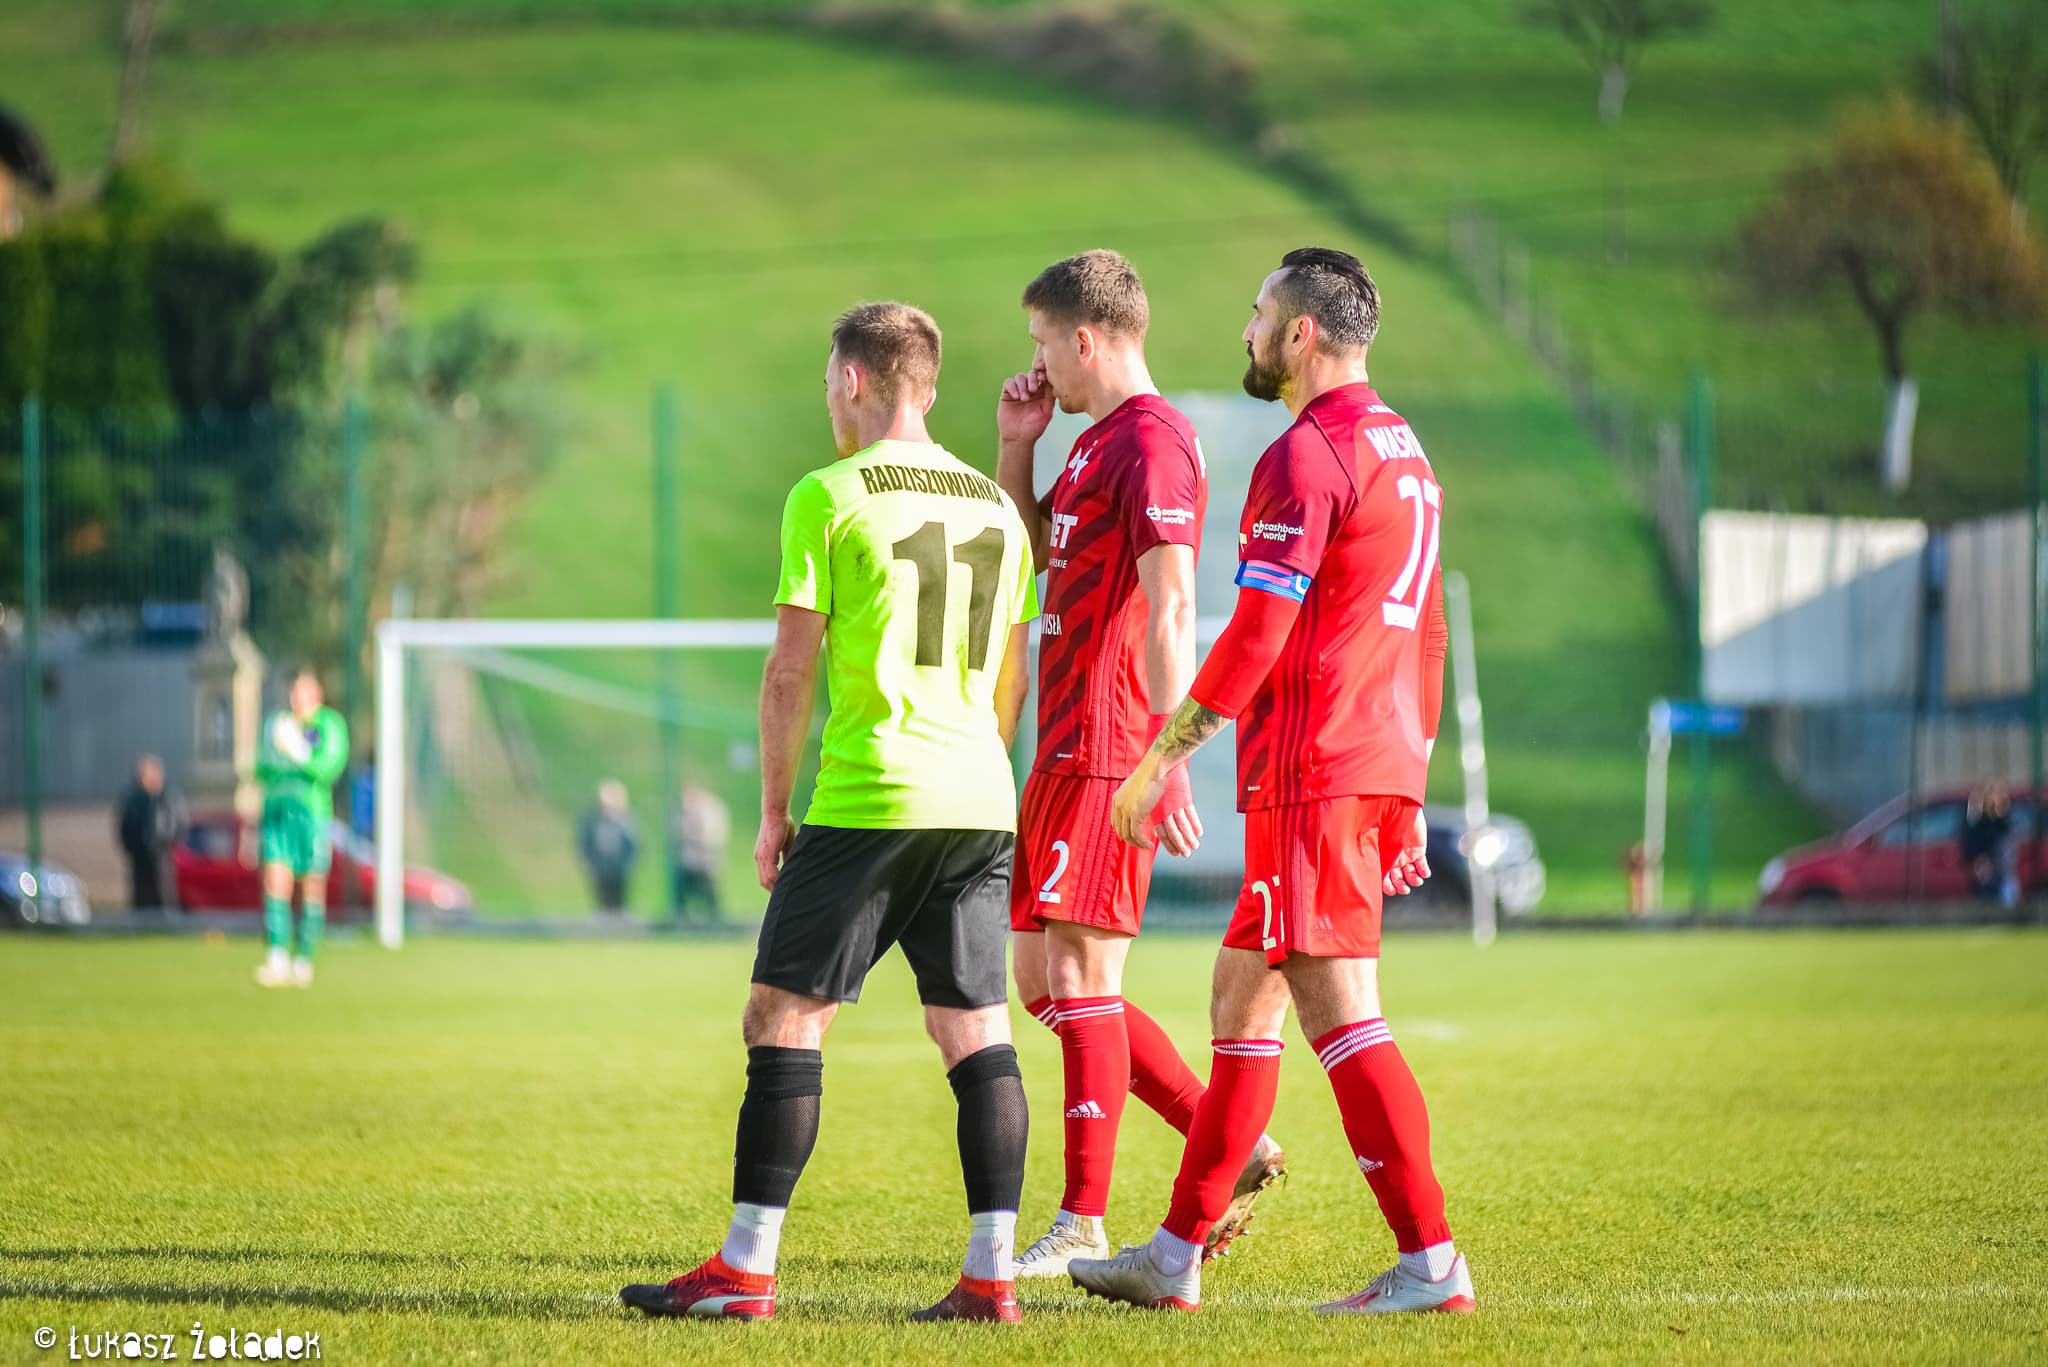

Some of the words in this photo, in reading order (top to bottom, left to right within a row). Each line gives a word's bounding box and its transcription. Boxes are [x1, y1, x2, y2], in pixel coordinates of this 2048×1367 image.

[859, 464, 1004, 508] RADZISZOWIANKA
[1263, 532, 1287, 542] world
[1264, 522, 1305, 536] cashback
[892, 521, 1005, 672] 11
[1038, 840, 1070, 904] 2
